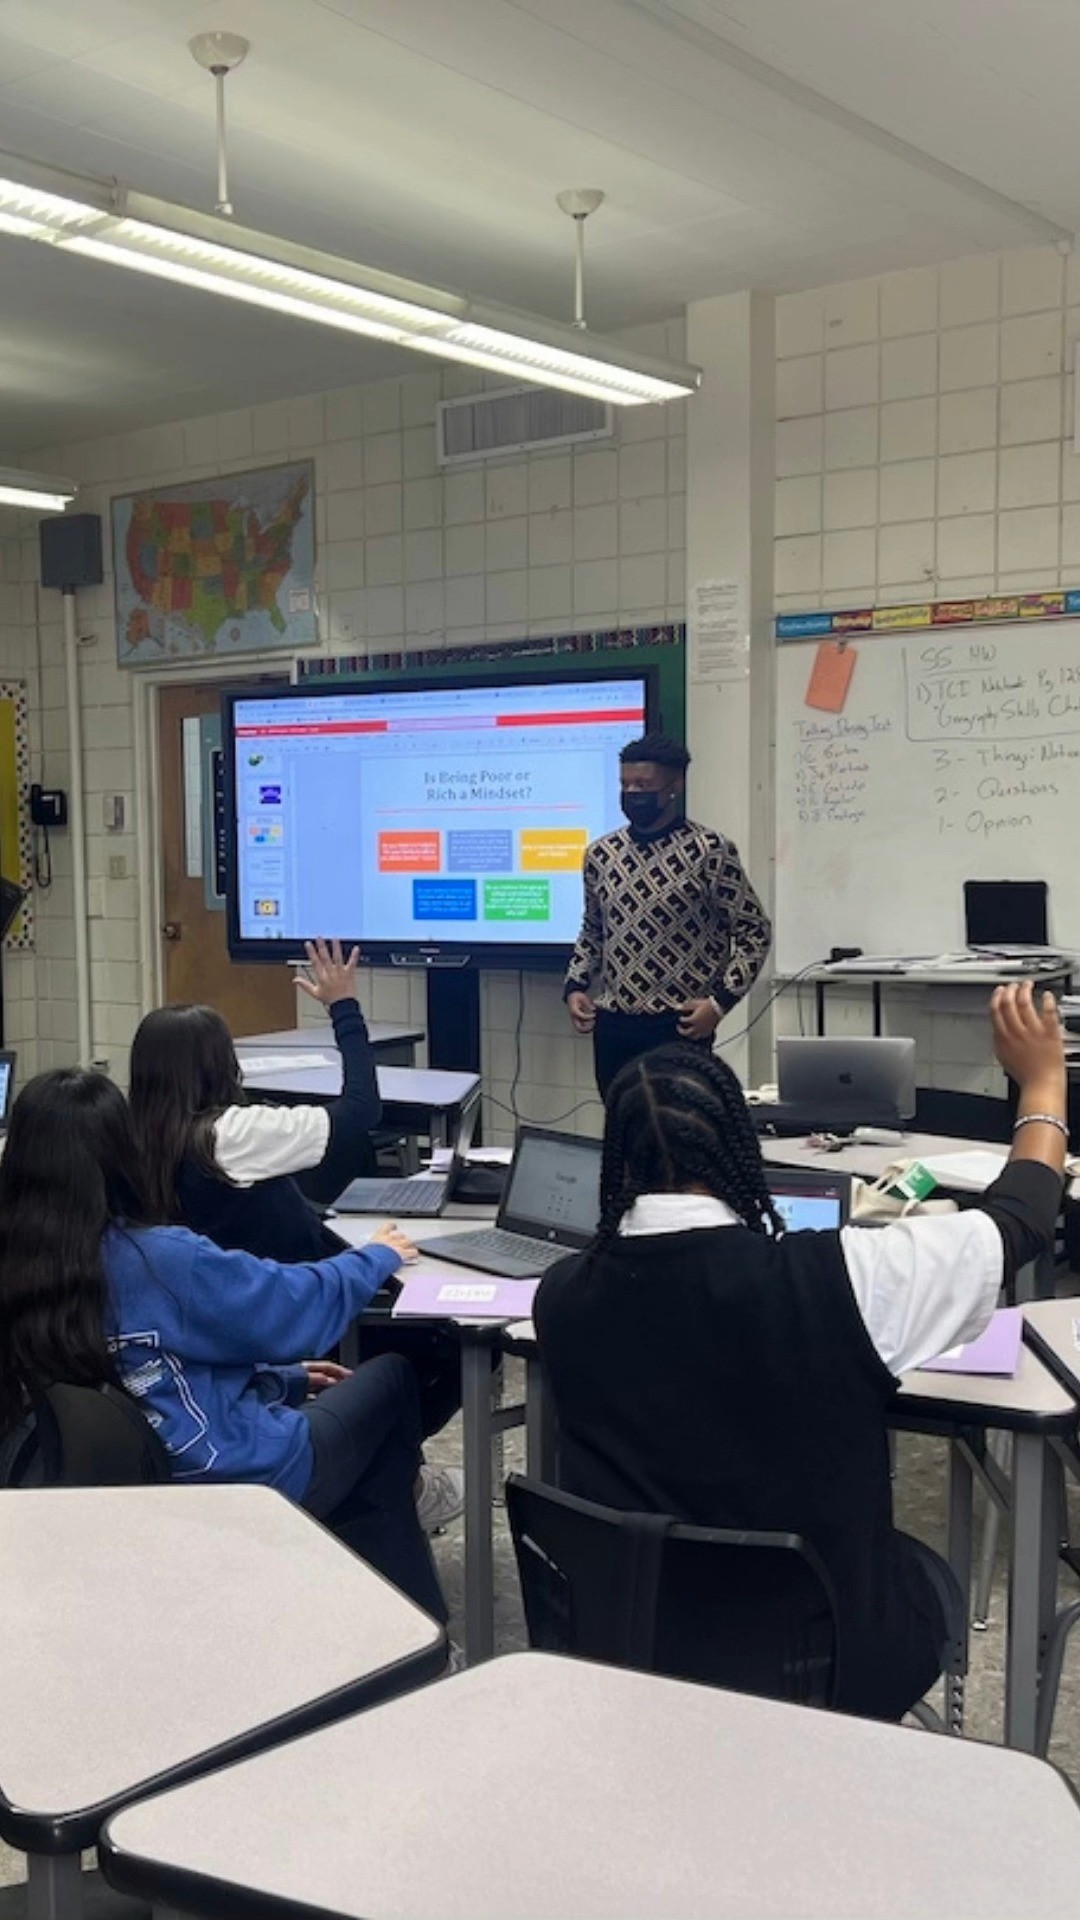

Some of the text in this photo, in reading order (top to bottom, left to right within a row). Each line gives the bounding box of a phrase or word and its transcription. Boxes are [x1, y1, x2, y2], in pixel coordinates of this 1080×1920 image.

[920, 644, 997, 671] SS HW
[424, 770, 531, 786] Is Being Poor or
[977, 777, 1058, 800] Questions
[426, 786, 533, 801] Rich a Mindset?
[965, 810, 1032, 840] Opinion
